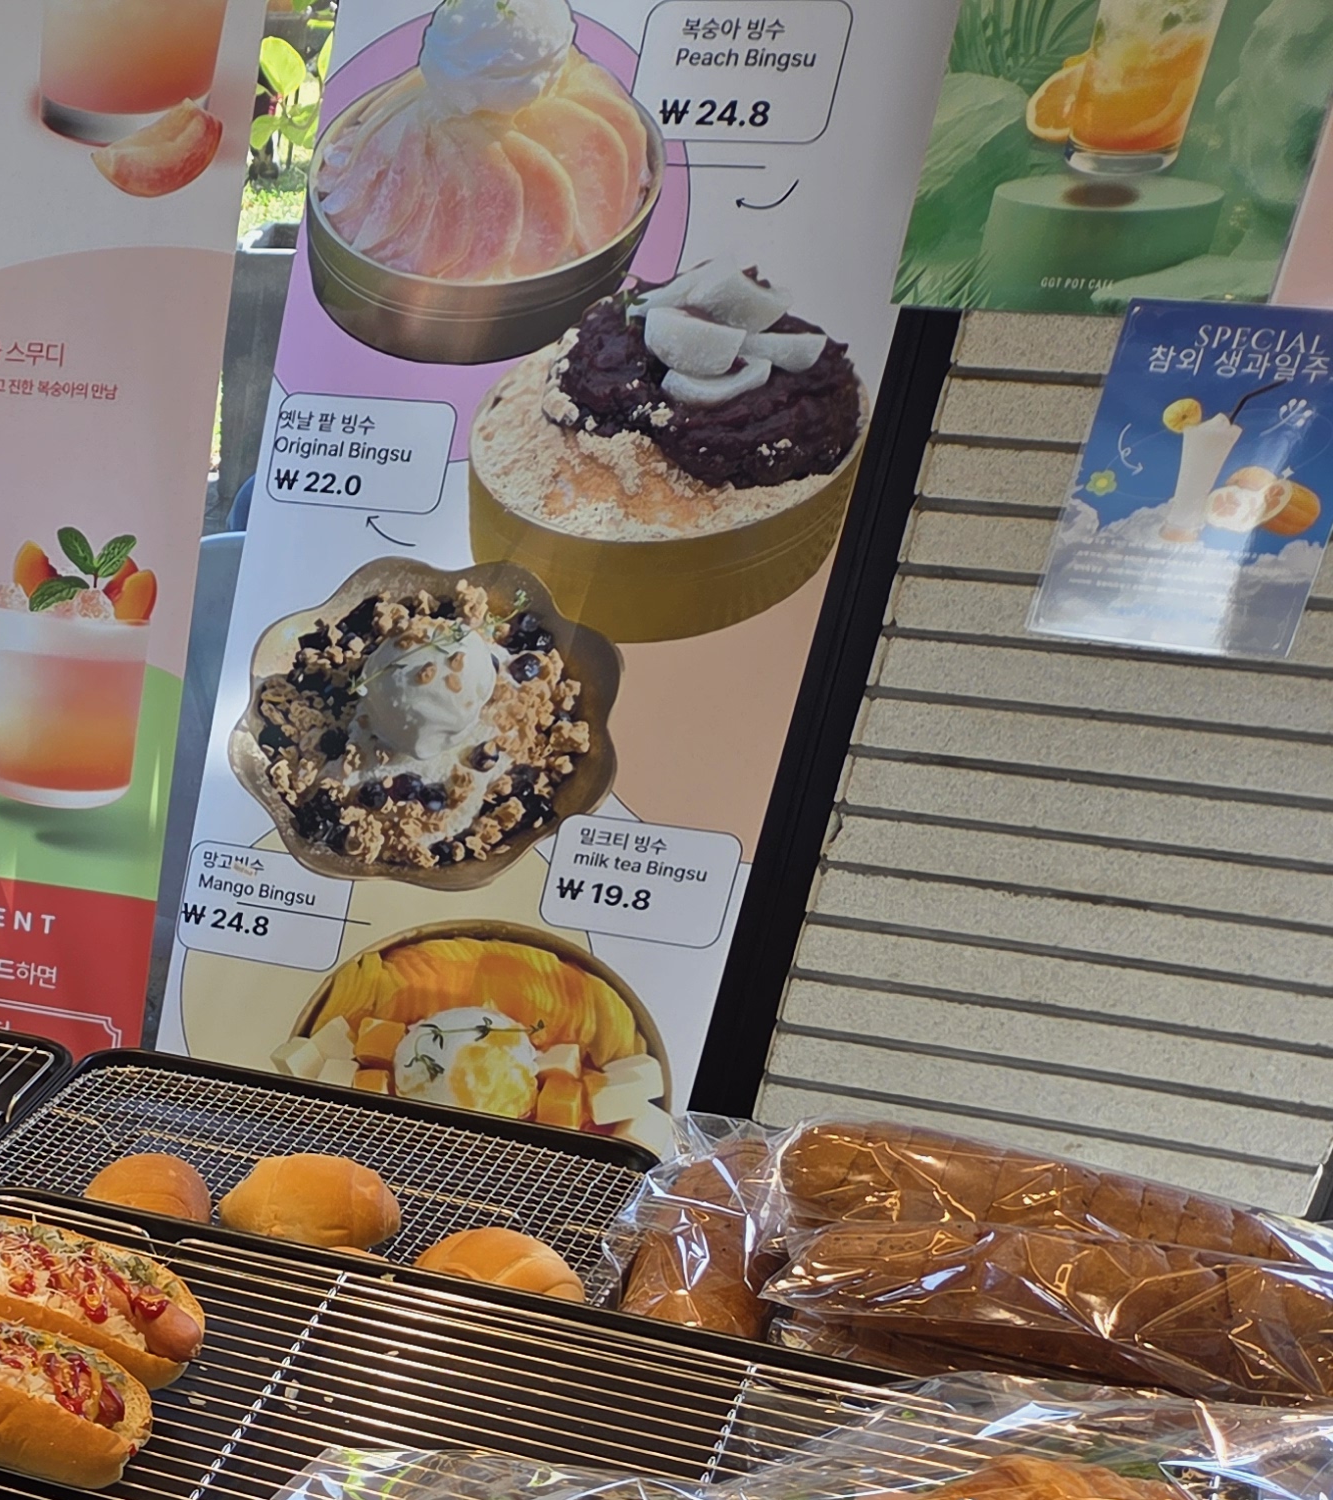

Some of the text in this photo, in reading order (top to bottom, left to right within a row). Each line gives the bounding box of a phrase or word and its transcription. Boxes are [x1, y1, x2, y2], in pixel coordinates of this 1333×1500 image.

[682, 17, 785, 41] 복숭아 빙수
[675, 47, 817, 72] Peach Bingsu
[695, 99, 771, 127] 24.8
[1194, 324, 1326, 355] SPECIAL
[5, 341, 64, 367] 스무디
[1148, 344, 1333, 383] 참외 생과일주
[9, 378, 34, 395] 진한
[38, 380, 89, 398] 복숭아의
[91, 383, 118, 400] 만남
[280, 409, 375, 436] 옛날 팥 빙수
[274, 436, 412, 465] Original Bingsu
[304, 471, 362, 496] 22.0
[580, 827, 668, 855] 밀크티 빙수
[573, 852, 708, 883] milk tea Bingsu
[198, 873, 316, 906] Mango Bingsu
[591, 882, 652, 910] 19.8
[211, 908, 269, 936] 24.8
